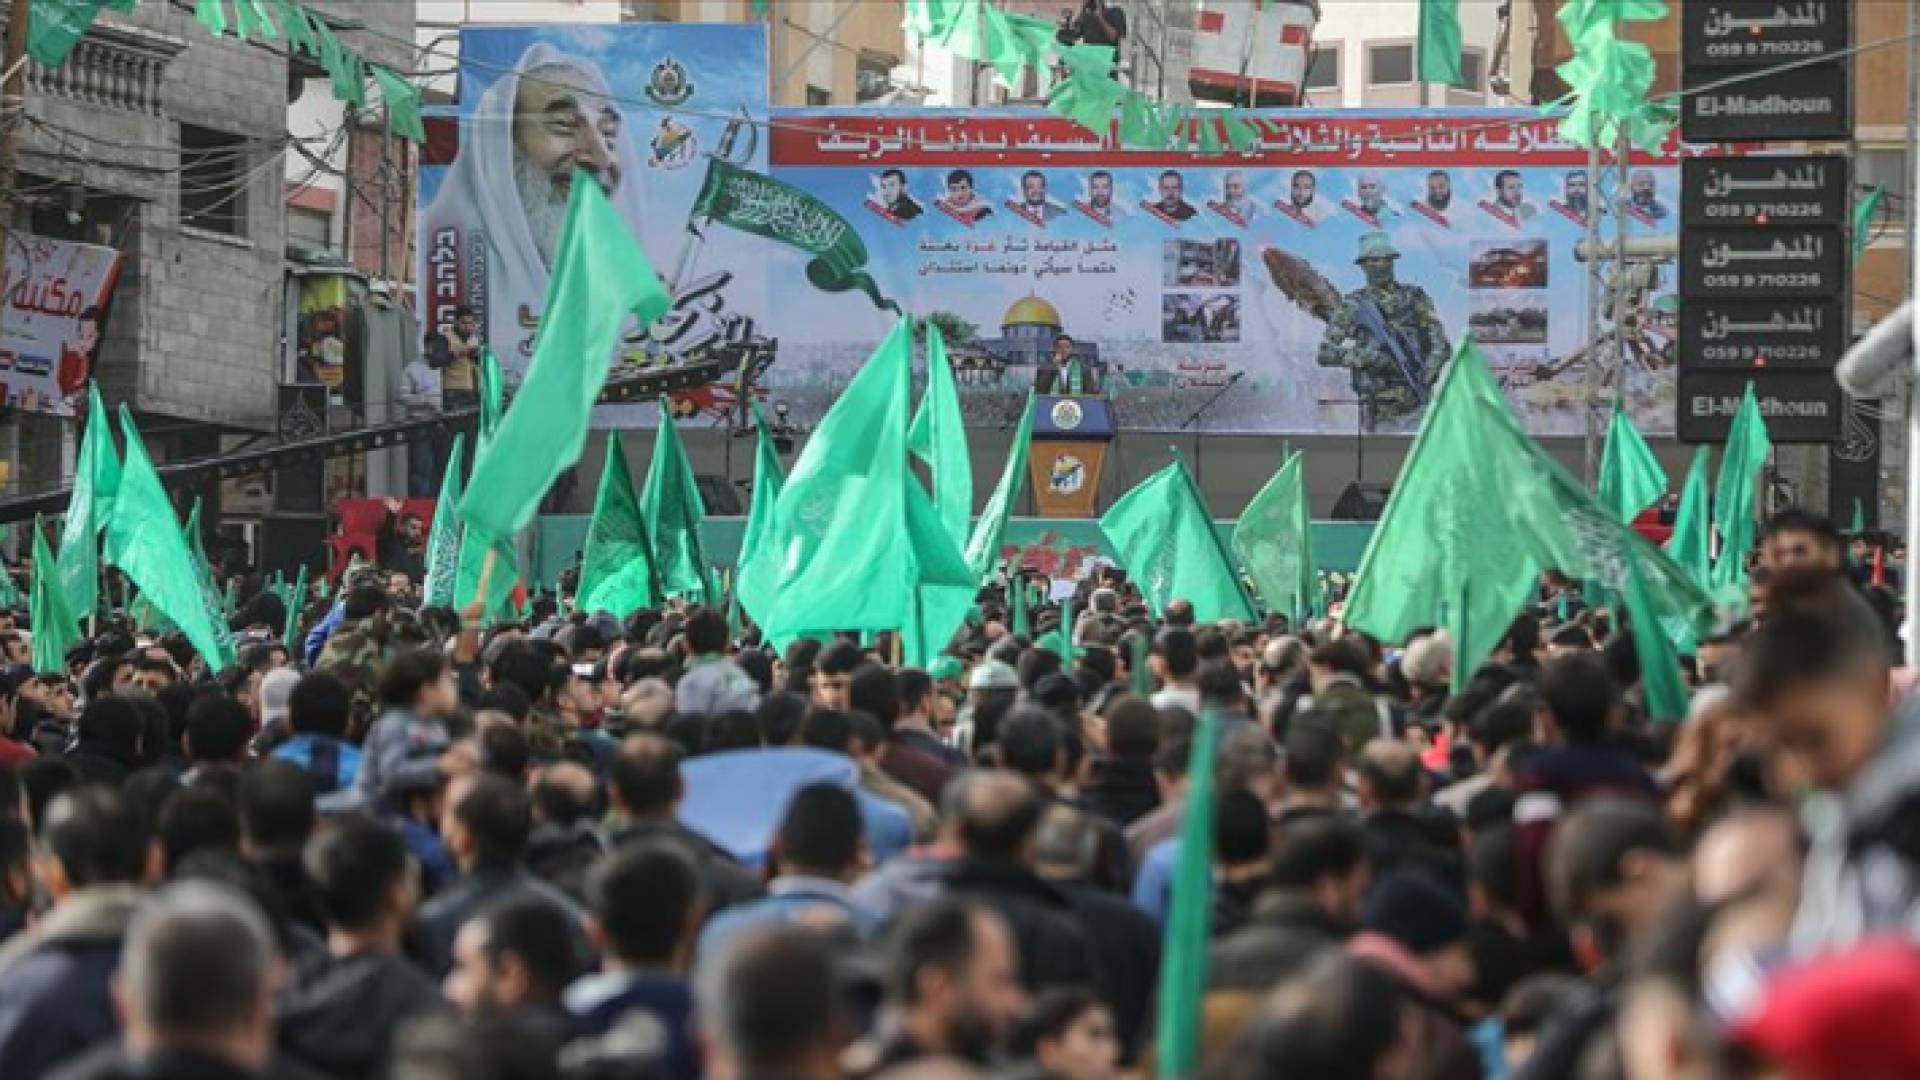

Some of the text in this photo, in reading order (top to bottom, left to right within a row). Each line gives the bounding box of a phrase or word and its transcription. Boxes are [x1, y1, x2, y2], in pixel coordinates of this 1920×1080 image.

[1703, 2, 1826, 36] المدهون
[1706, 43, 1742, 57] 059
[1695, 95, 1832, 115] El-Madhoun
[1703, 163, 1825, 197] المدهون
[1705, 204, 1740, 217] 059
[1701, 234, 1824, 268] المدهون
[1704, 274, 1739, 288] 059
[1701, 306, 1823, 339] المدهون
[1703, 346, 1738, 360] 059
[1692, 396, 1827, 417] El-Mdhoun
